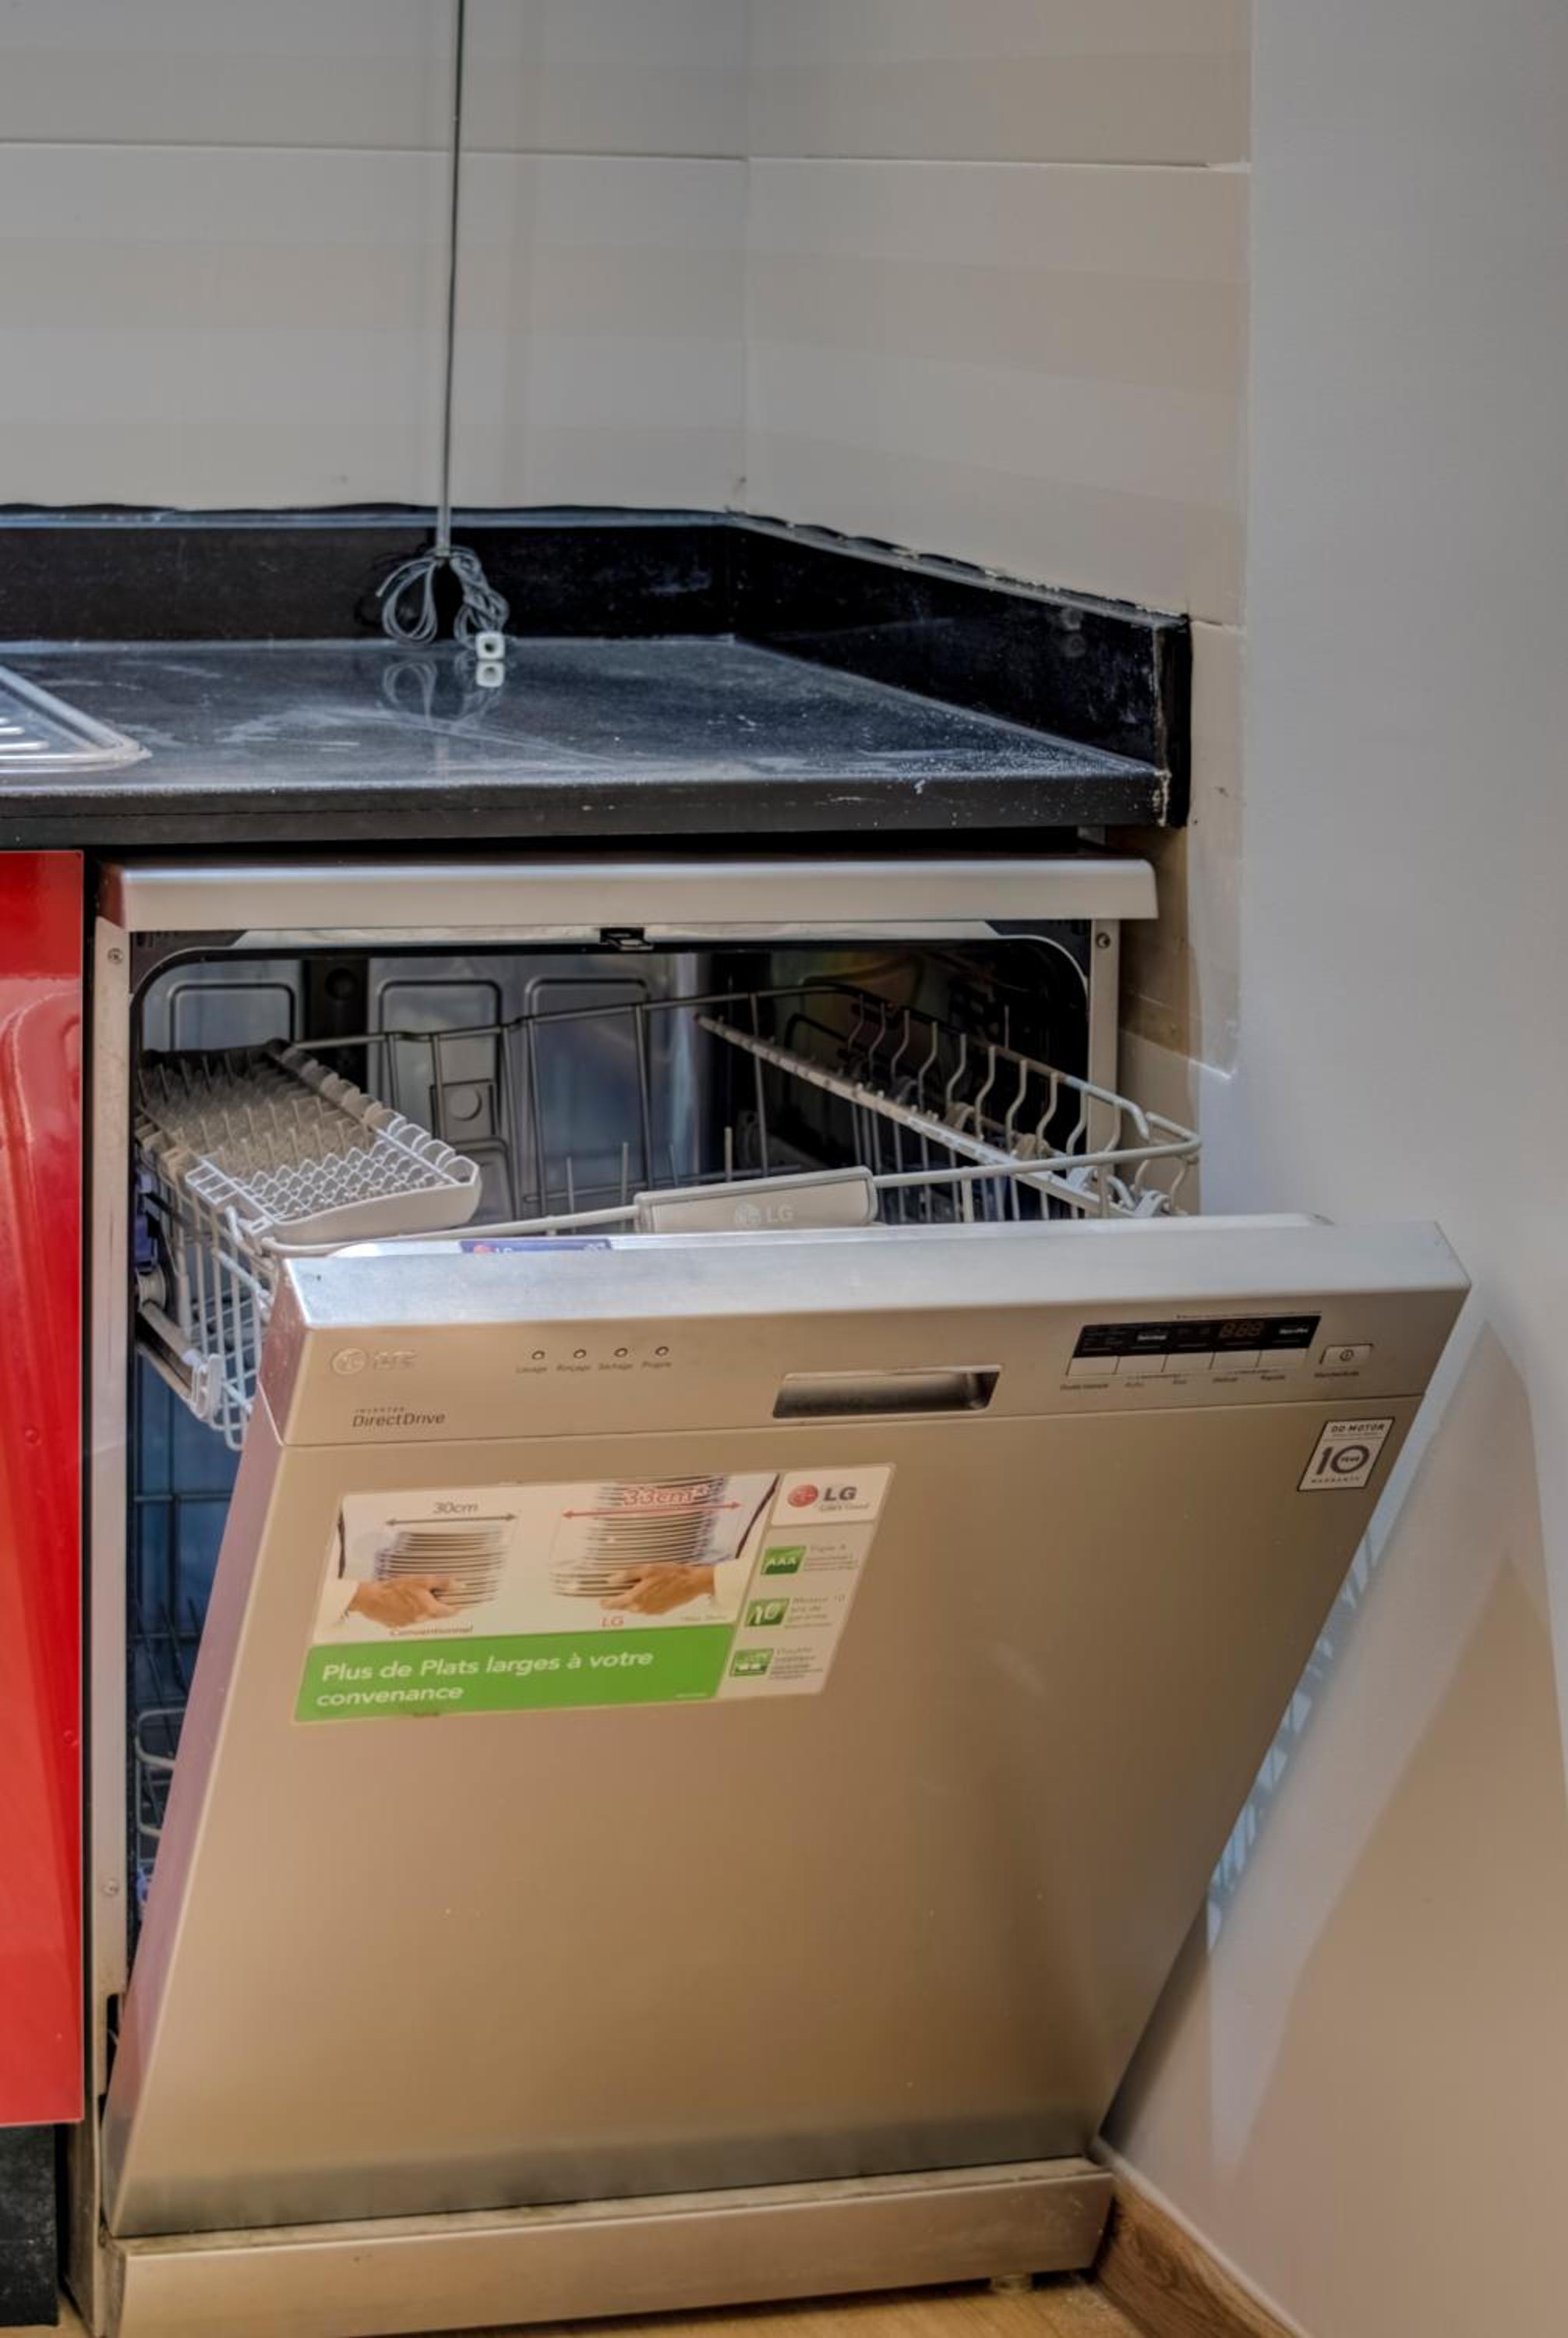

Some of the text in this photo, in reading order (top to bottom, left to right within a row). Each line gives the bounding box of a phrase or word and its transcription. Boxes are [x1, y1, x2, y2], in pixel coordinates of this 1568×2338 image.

[765, 1203, 794, 1224] LG
[351, 1412, 447, 1428] DirectDrive
[1348, 1423, 1385, 1432] MOTOR
[1315, 1444, 1370, 1475] 10
[823, 1485, 857, 1502] LG
[432, 1500, 479, 1514] 30cm
[599, 1615, 624, 1628] LG
[322, 1651, 655, 1682] Plus de Plats larges à votre
[316, 1686, 464, 1708] convenance
